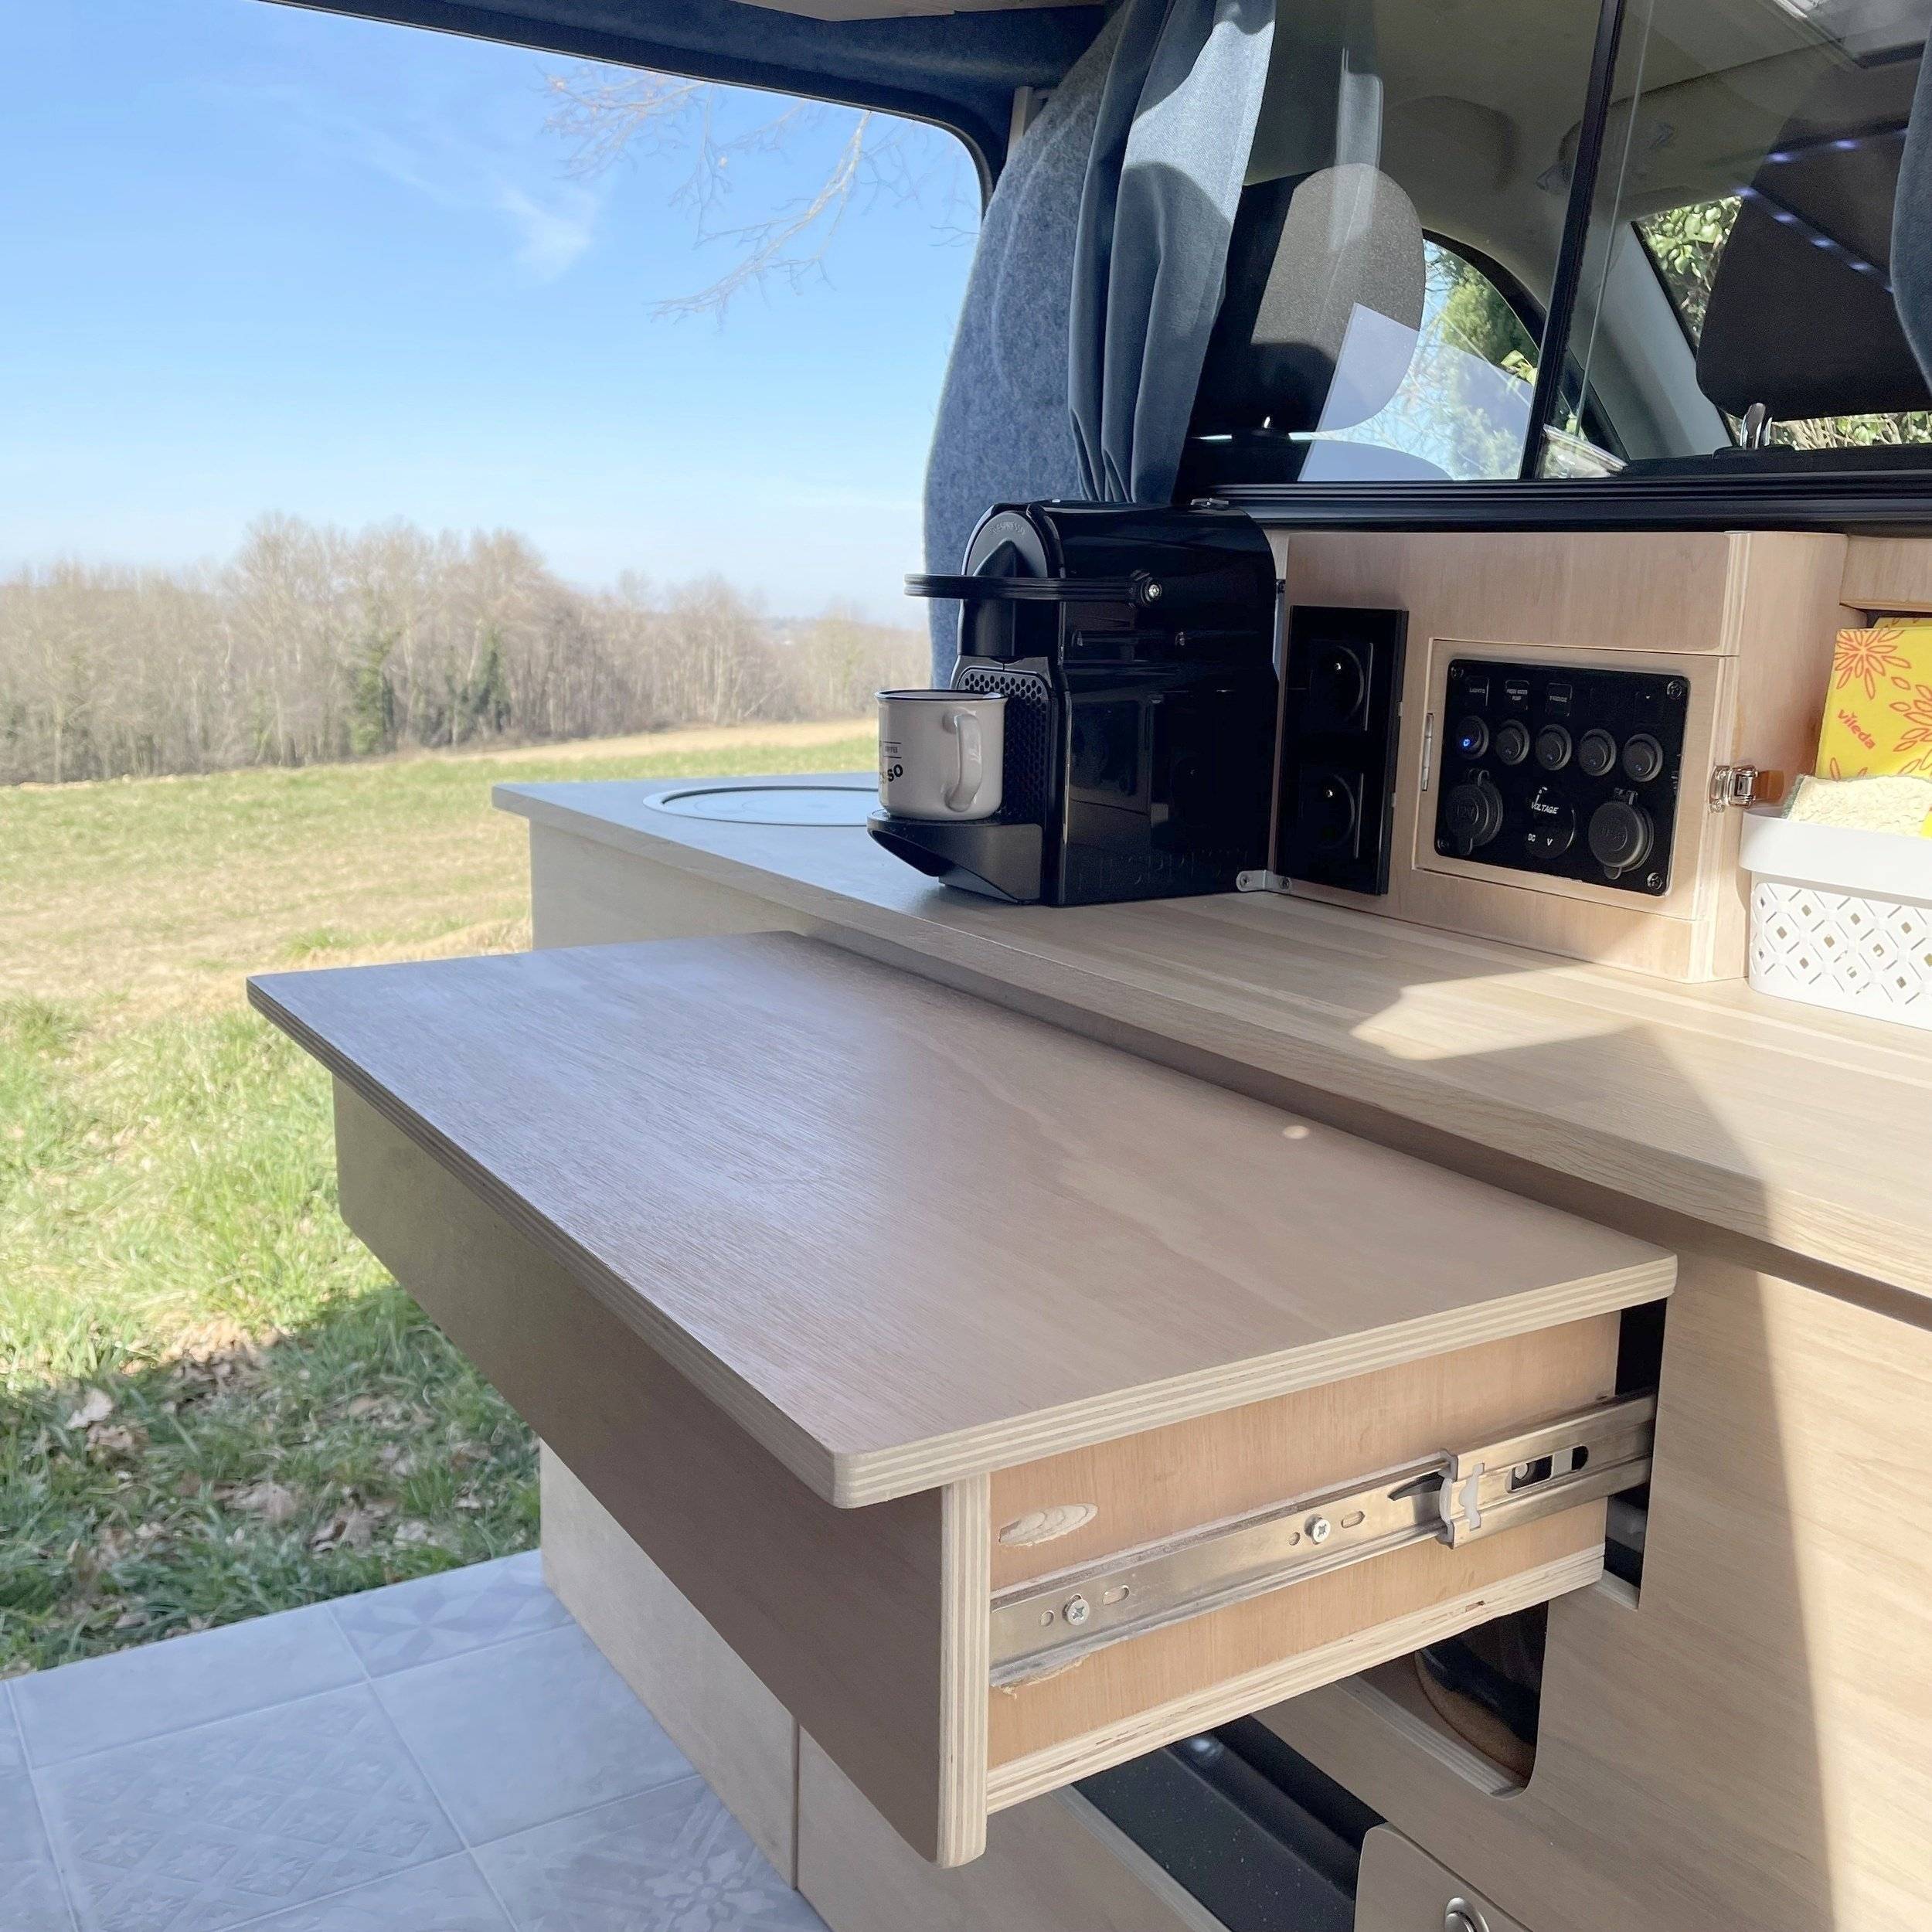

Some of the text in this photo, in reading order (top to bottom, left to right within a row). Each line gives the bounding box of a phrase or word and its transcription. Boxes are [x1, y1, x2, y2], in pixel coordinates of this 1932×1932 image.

[1838, 709, 1876, 750] vileda
[1531, 801, 1560, 815] VOLTAGE
[1527, 833, 1553, 846] DC V
